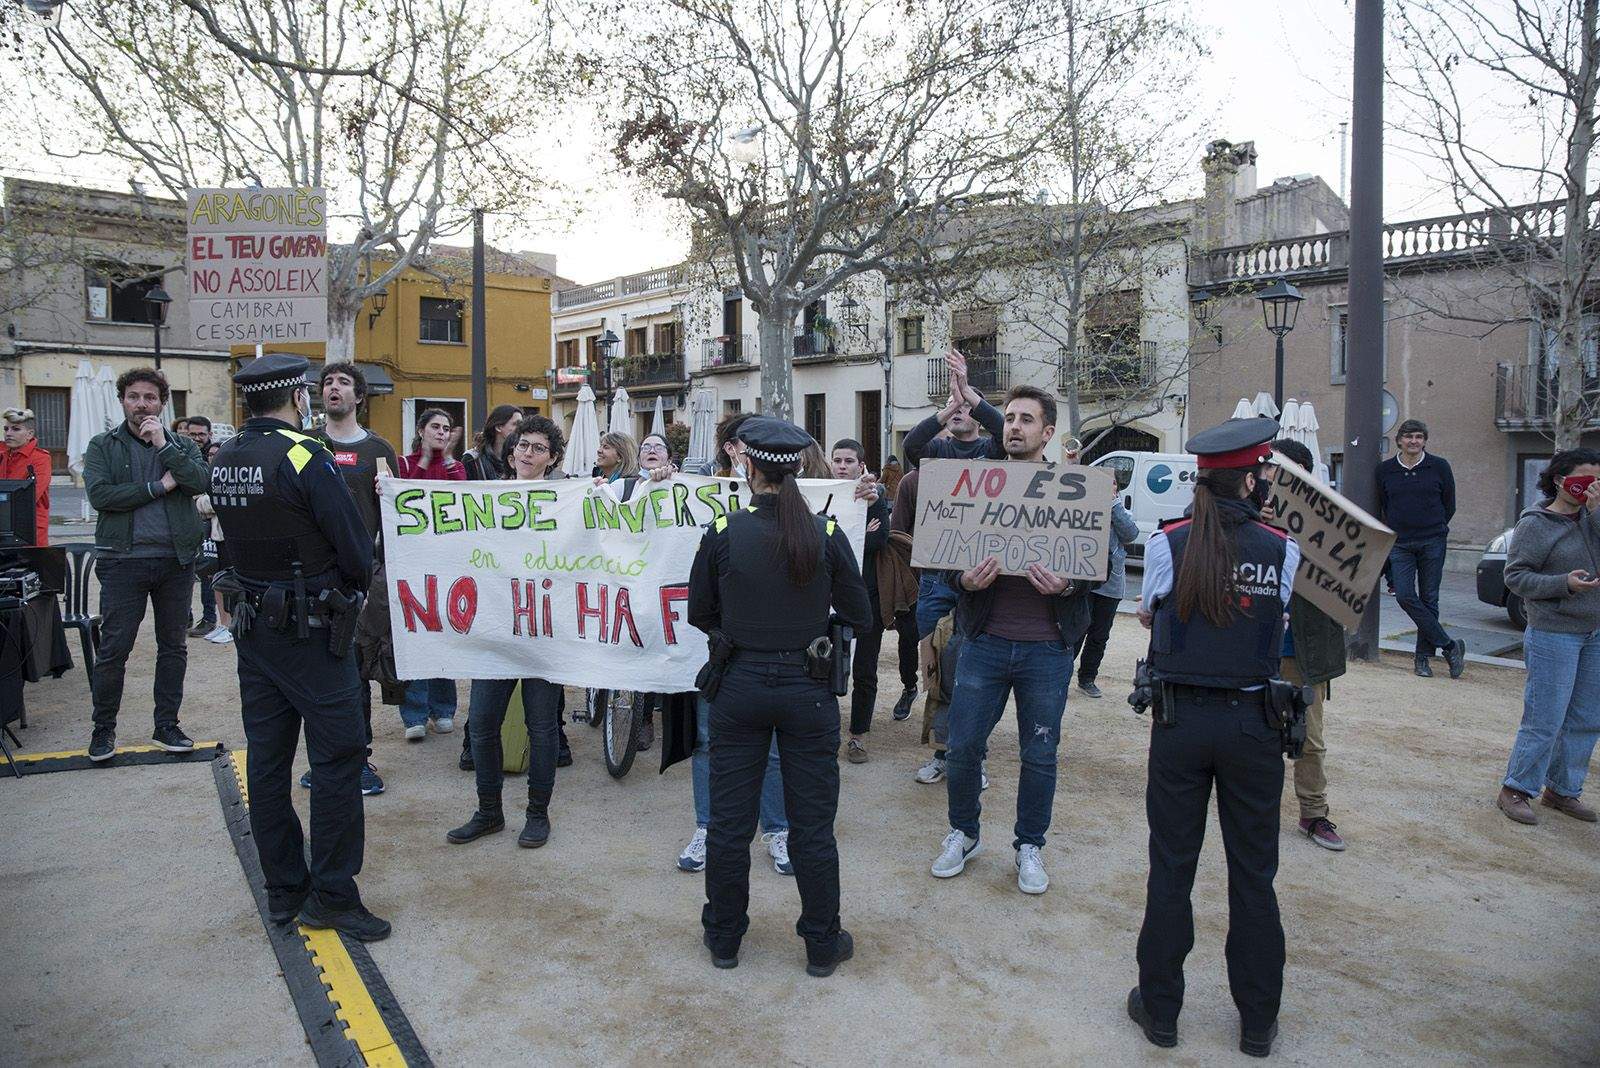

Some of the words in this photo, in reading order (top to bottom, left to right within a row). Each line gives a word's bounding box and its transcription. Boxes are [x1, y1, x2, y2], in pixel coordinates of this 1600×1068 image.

[191, 189, 324, 227] ARAGONÈS
[191, 236, 223, 260] EL
[225, 235, 265, 260] TEU
[269, 234, 327, 259] GOVERN
[193, 270, 221, 294] NO
[228, 267, 321, 294] ASSOLEIX
[210, 301, 294, 319] CAMBRAY
[196, 321, 312, 341] CESSAMENT
[211, 466, 264, 483] POLICIA
[211, 482, 222, 494] Sant
[222, 483, 237, 497] Cugat
[237, 484, 247, 494] del
[950, 467, 1008, 498] NO
[1023, 463, 1087, 501] ÉS
[394, 488, 558, 535] SENSE
[980, 501, 1104, 531] HONORABLE
[1271, 495, 1304, 534] NO
[1308, 531, 1325, 549] A
[468, 547, 500, 569] en
[523, 540, 651, 577] educació
[931, 529, 1099, 577] IMPOSAR
[1297, 553, 1367, 614] TITZACIÓ
[396, 574, 478, 635] NO
[575, 582, 644, 648] HA
